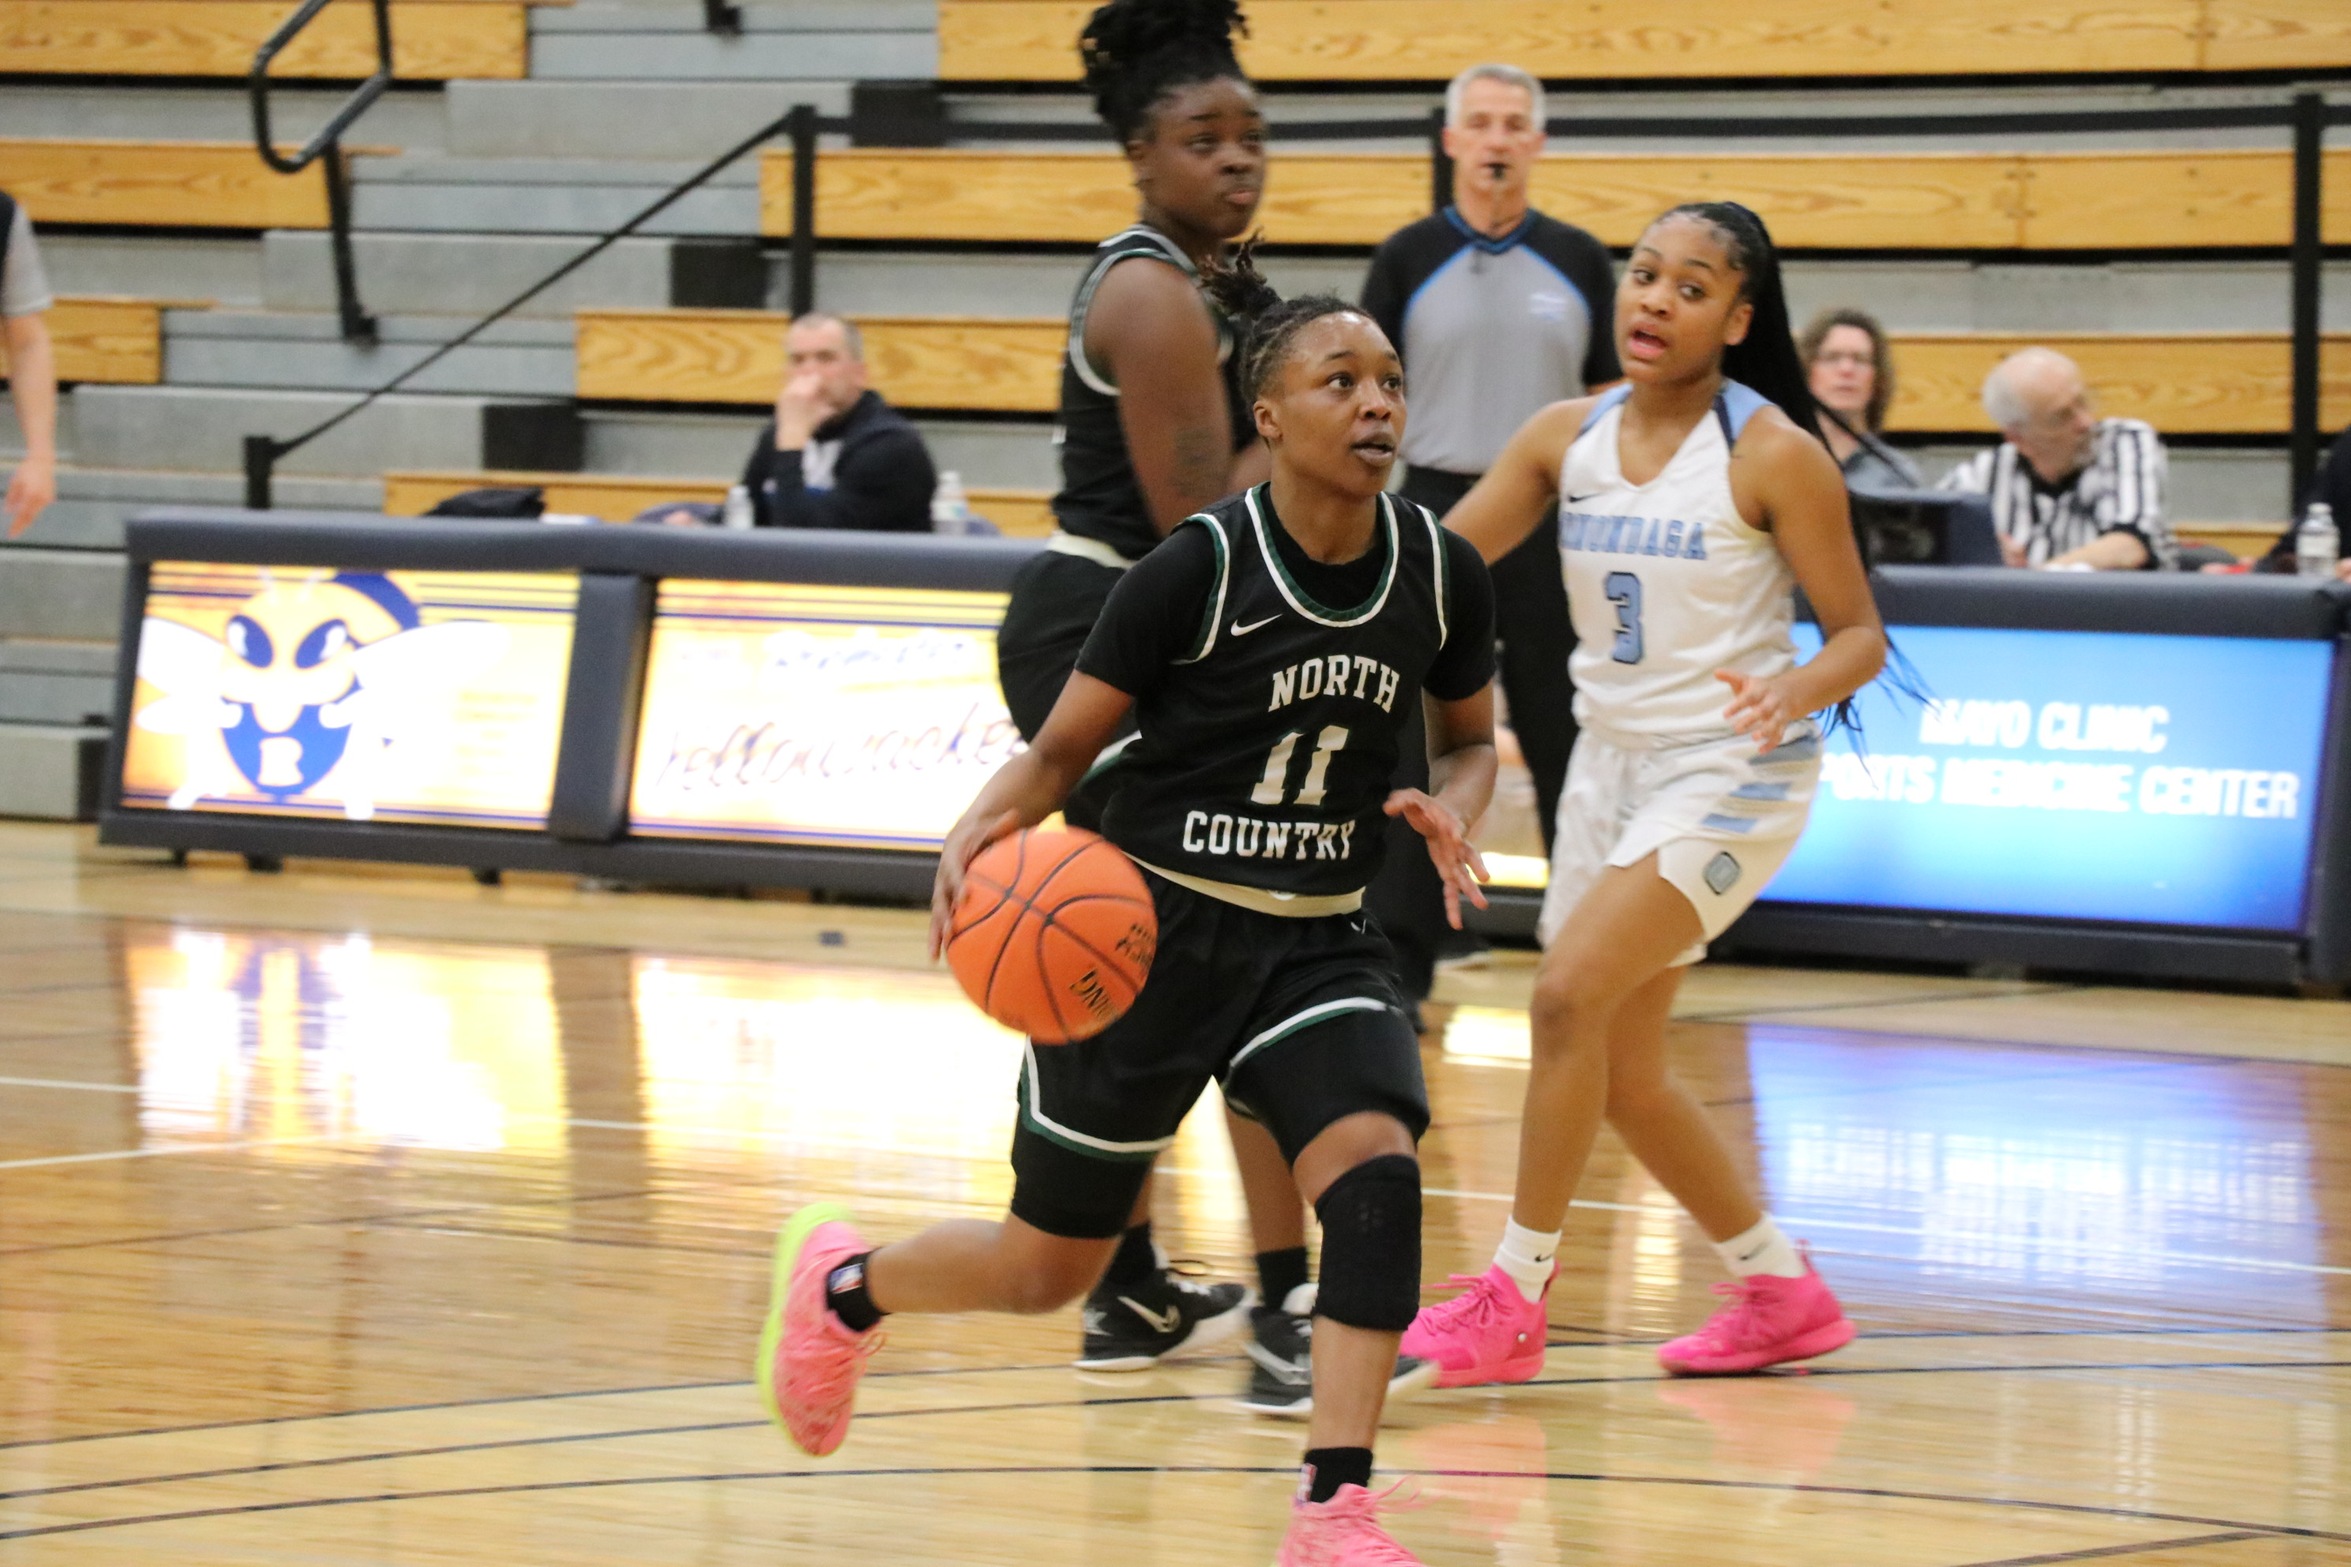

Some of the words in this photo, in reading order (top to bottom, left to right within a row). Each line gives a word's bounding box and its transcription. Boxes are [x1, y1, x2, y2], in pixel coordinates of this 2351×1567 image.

[1560, 511, 1708, 561] NDAGA
[1603, 571, 1643, 665] 3
[1268, 655, 1400, 714] NORTH
[1919, 698, 2031, 749] MAYO
[2038, 701, 2170, 754] CLINIC
[1250, 725, 1349, 806] 11
[1819, 752, 1937, 804] PORTS
[1941, 757, 2134, 812] MEDICINE
[2138, 765, 2300, 819] CENTER
[1182, 810, 1356, 860] COUNTRY
